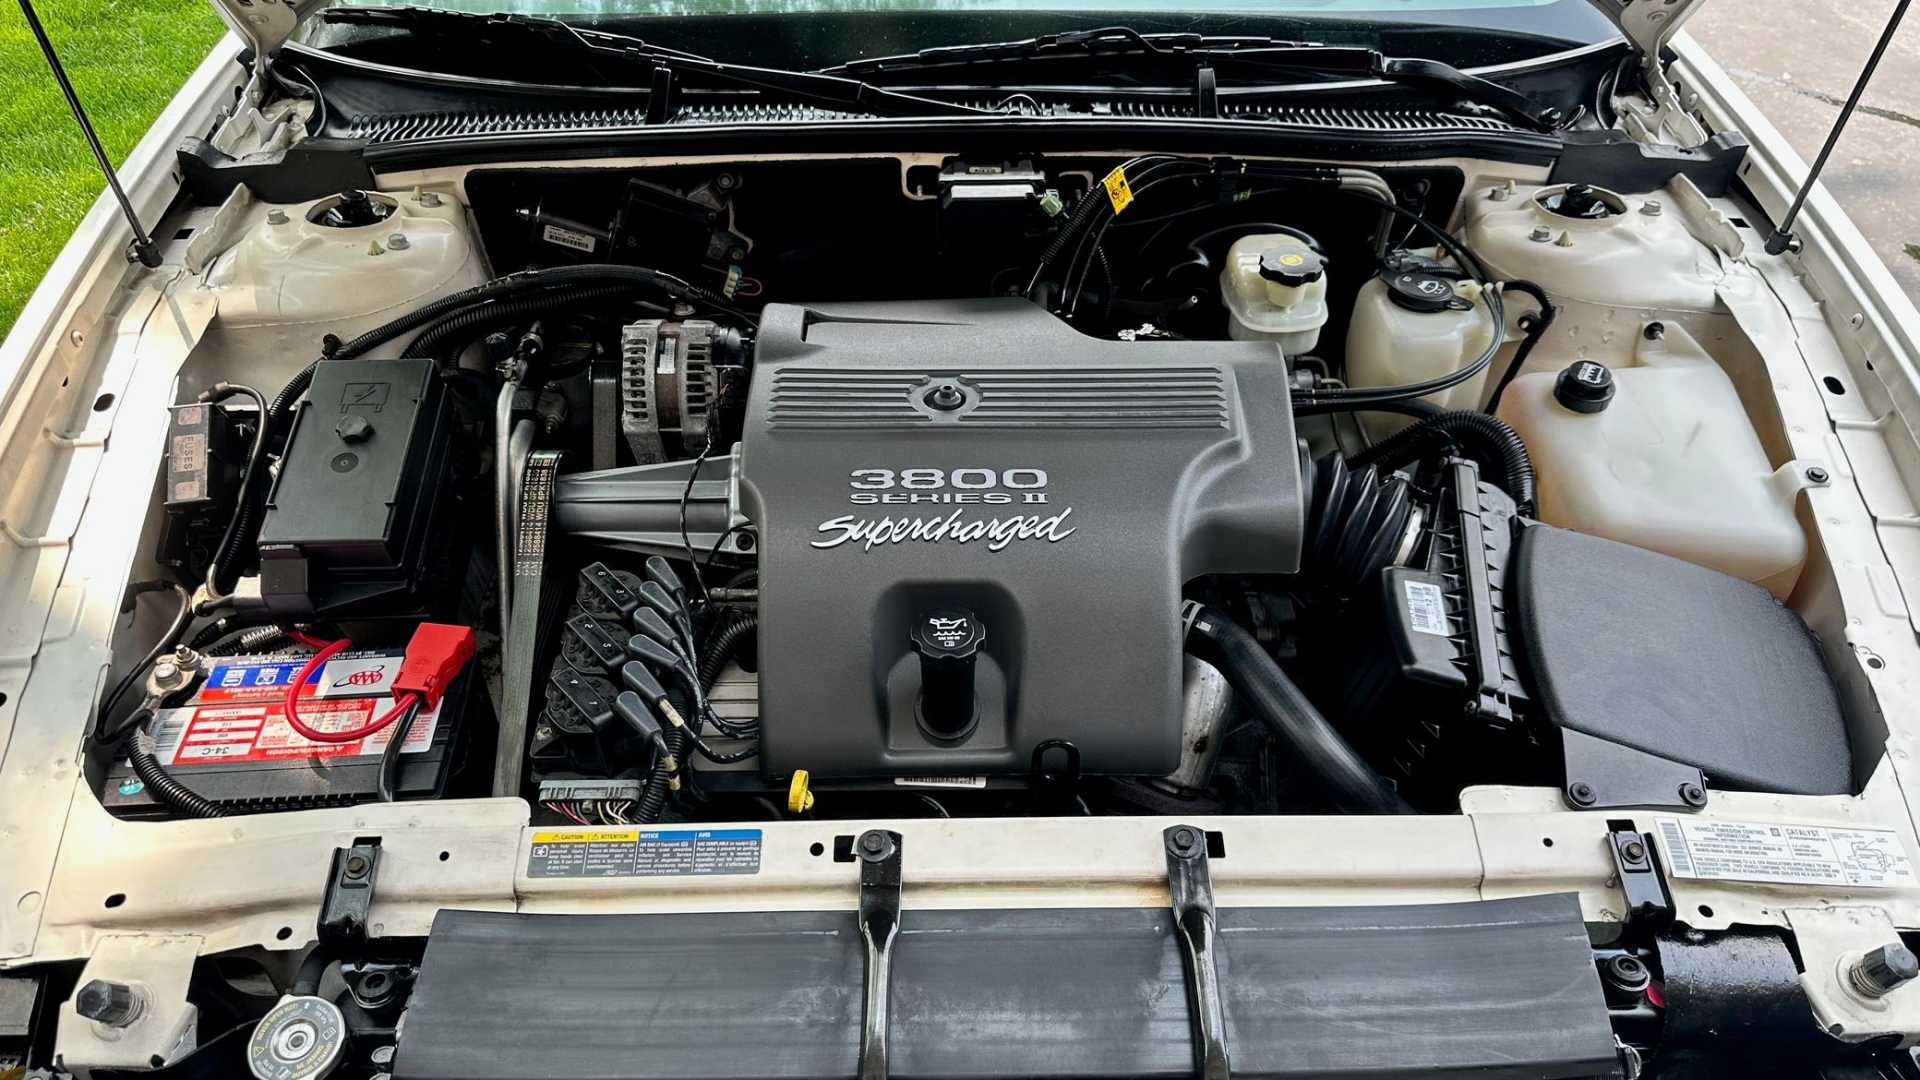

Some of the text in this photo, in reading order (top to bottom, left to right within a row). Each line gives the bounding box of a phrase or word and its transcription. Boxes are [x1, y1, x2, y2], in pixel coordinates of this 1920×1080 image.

[183, 437, 194, 470] FUSES
[849, 468, 1048, 489] 3800
[850, 493, 1049, 504] SERIES II
[810, 507, 1077, 551] Supercharged
[349, 671, 383, 685] AAA
[202, 746, 229, 755] 34-C
